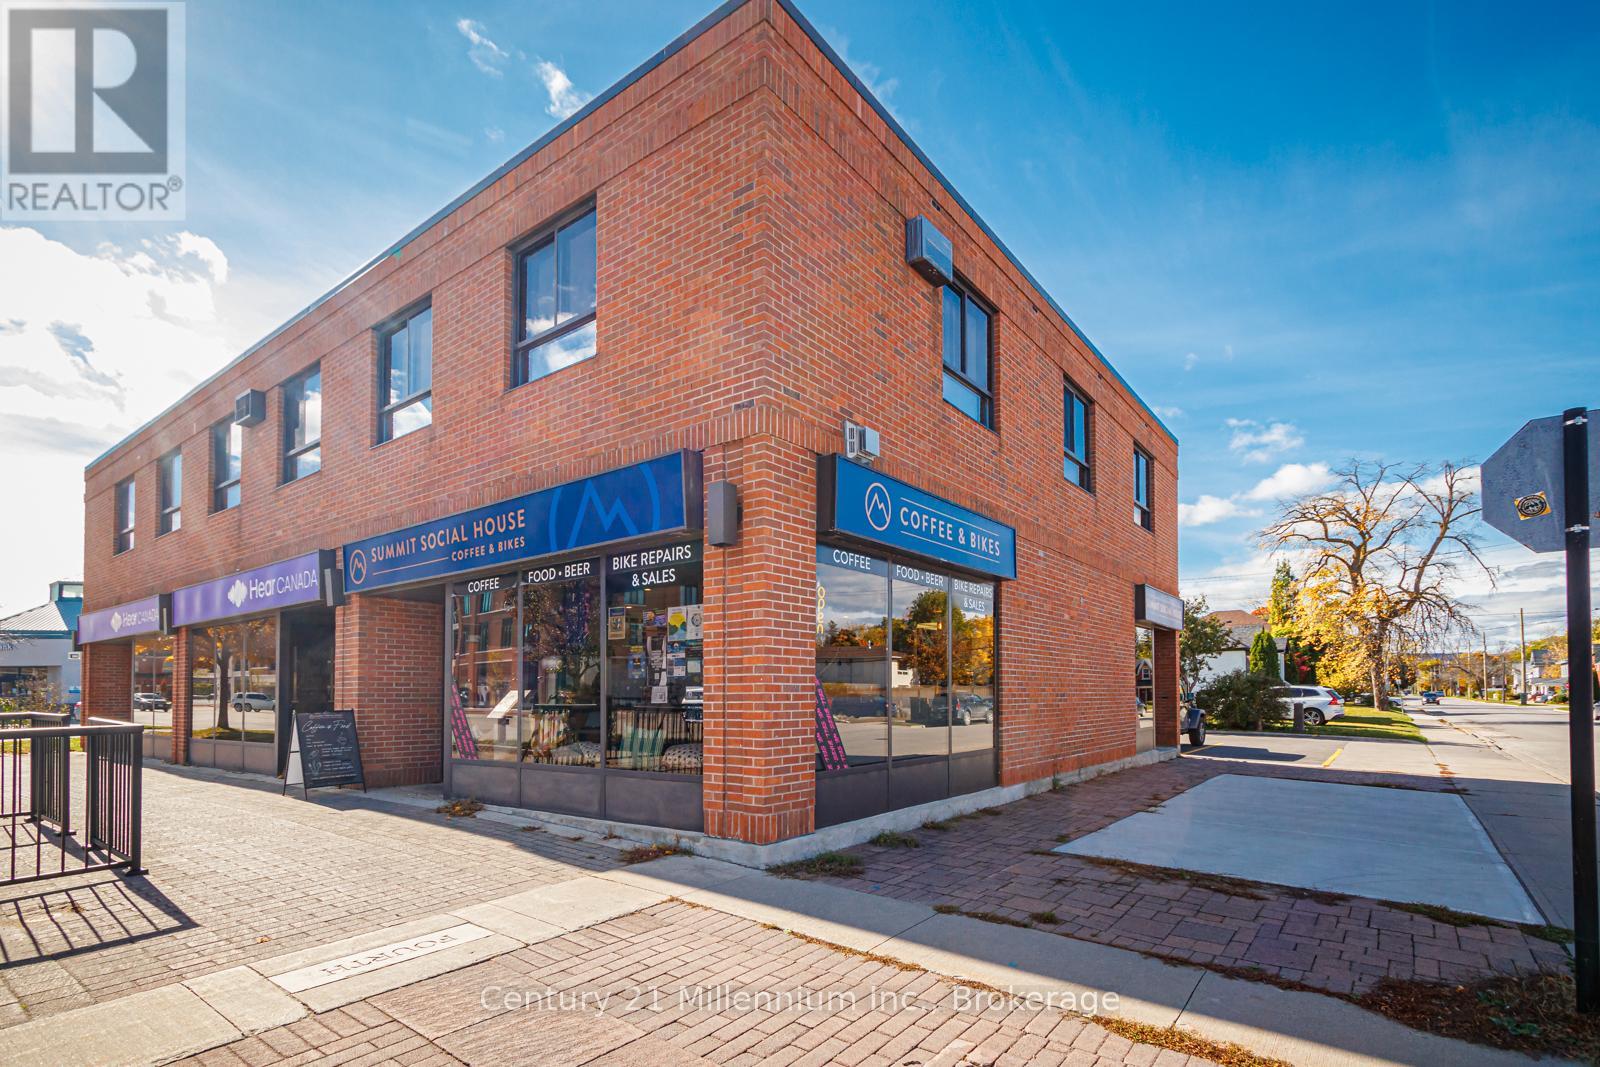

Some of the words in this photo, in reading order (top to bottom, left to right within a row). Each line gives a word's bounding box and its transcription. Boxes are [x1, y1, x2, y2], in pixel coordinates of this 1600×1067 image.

[371, 537, 417, 562] SUMMIT
[420, 525, 469, 551] SOCIAL
[473, 508, 525, 539] HOUSE
[900, 506, 954, 541] COFFEE
[958, 527, 966, 545] &
[970, 532, 1000, 557] BIKES
[451, 545, 486, 561] COFFEE
[488, 543, 495, 554] &
[498, 536, 525, 552] BIKES
[612, 554, 637, 570] BIKE
[641, 544, 692, 566] REPAIRS
[832, 549, 871, 570] COFFEE
[528, 568, 556, 583] FOOD
[564, 562, 590, 578] BEER
[632, 573, 640, 587] &
[641, 568, 676, 585] SALES
[896, 565, 920, 581] FOOD
[925, 572, 944, 587] BEER
[468, 577, 500, 593] COFFEE
[954, 579, 968, 592] BIKE
[969, 582, 993, 598] REPAIRS
[963, 597, 968, 607] &
[969, 598, 985, 611] SALES
[321, 935, 457, 975] FOURTH
